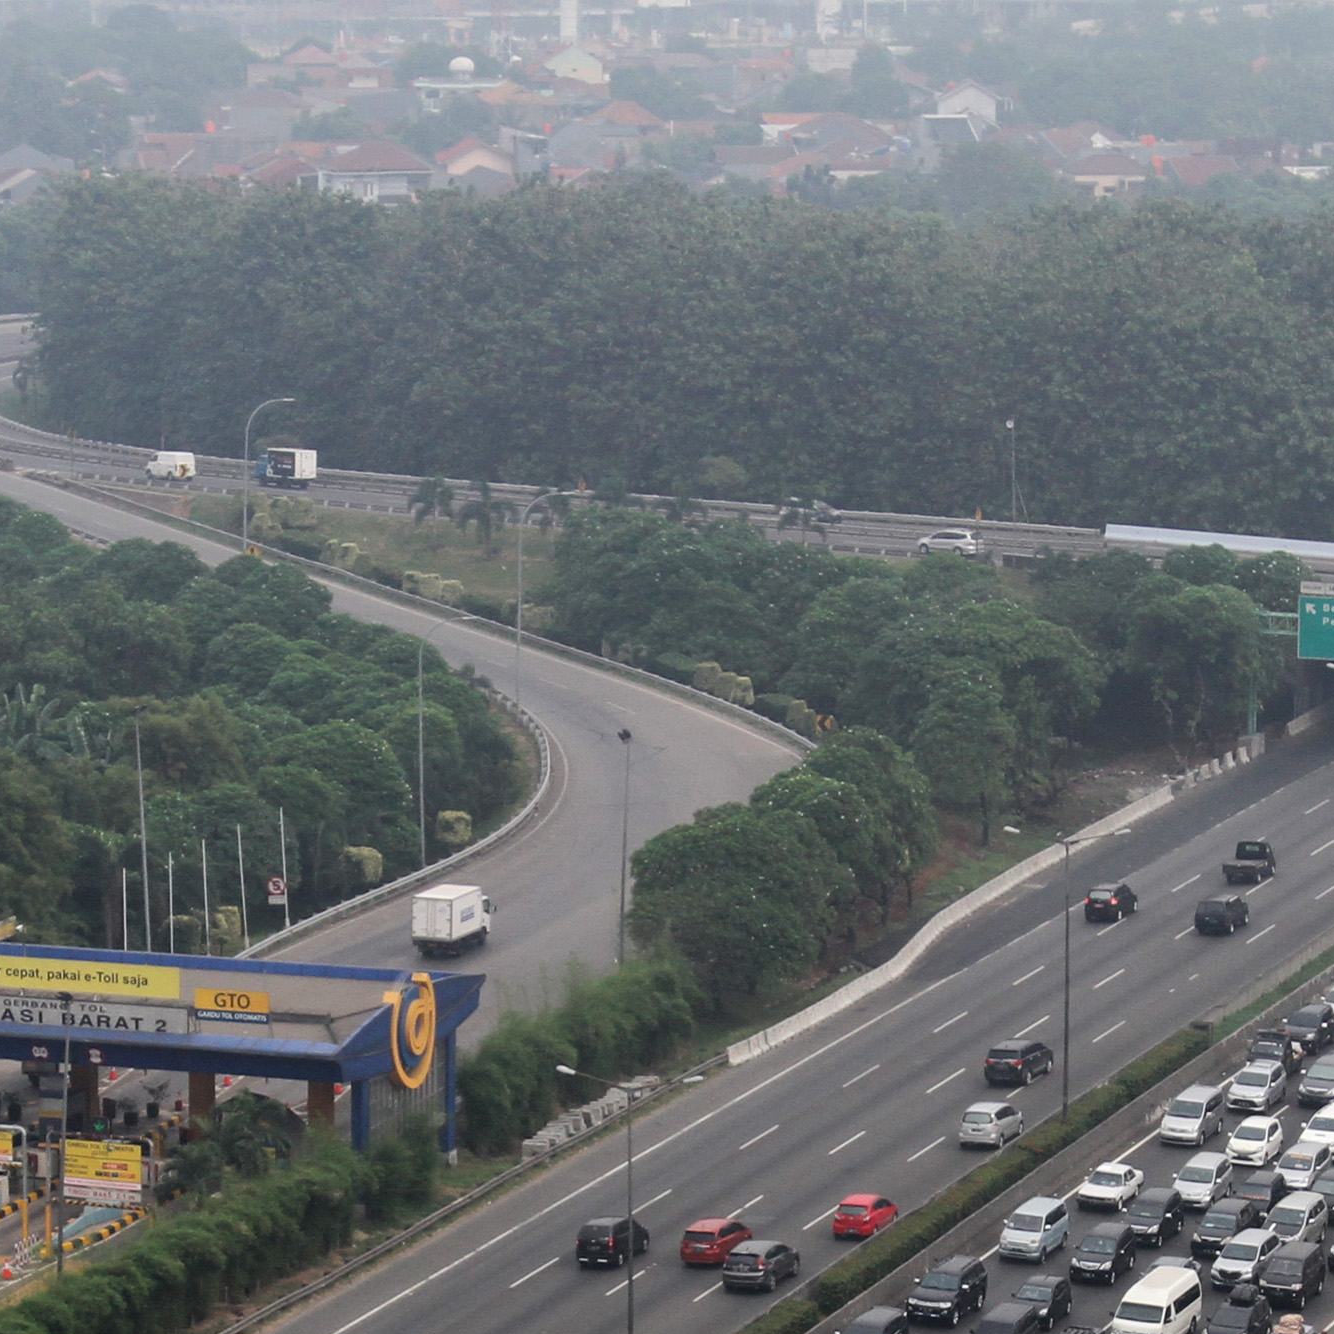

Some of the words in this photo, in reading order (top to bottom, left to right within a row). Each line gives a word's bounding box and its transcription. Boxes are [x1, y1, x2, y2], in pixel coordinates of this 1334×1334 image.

[5, 968, 43, 981] cepat,
[47, 968, 81, 982] pakai
[84, 970, 119, 984] e-Toll
[123, 975, 148, 986] saja
[3, 998, 68, 1011] GERBANG
[79, 1003, 105, 1013] TOL
[214, 992, 251, 1008] GTO
[62, 1012, 144, 1032] BARAT
[155, 1019, 168, 1032] 2
[197, 1010, 220, 1019] GARDU
[221, 1012, 233, 1020] TOL
[234, 1012, 267, 1022] OTOMATIS
